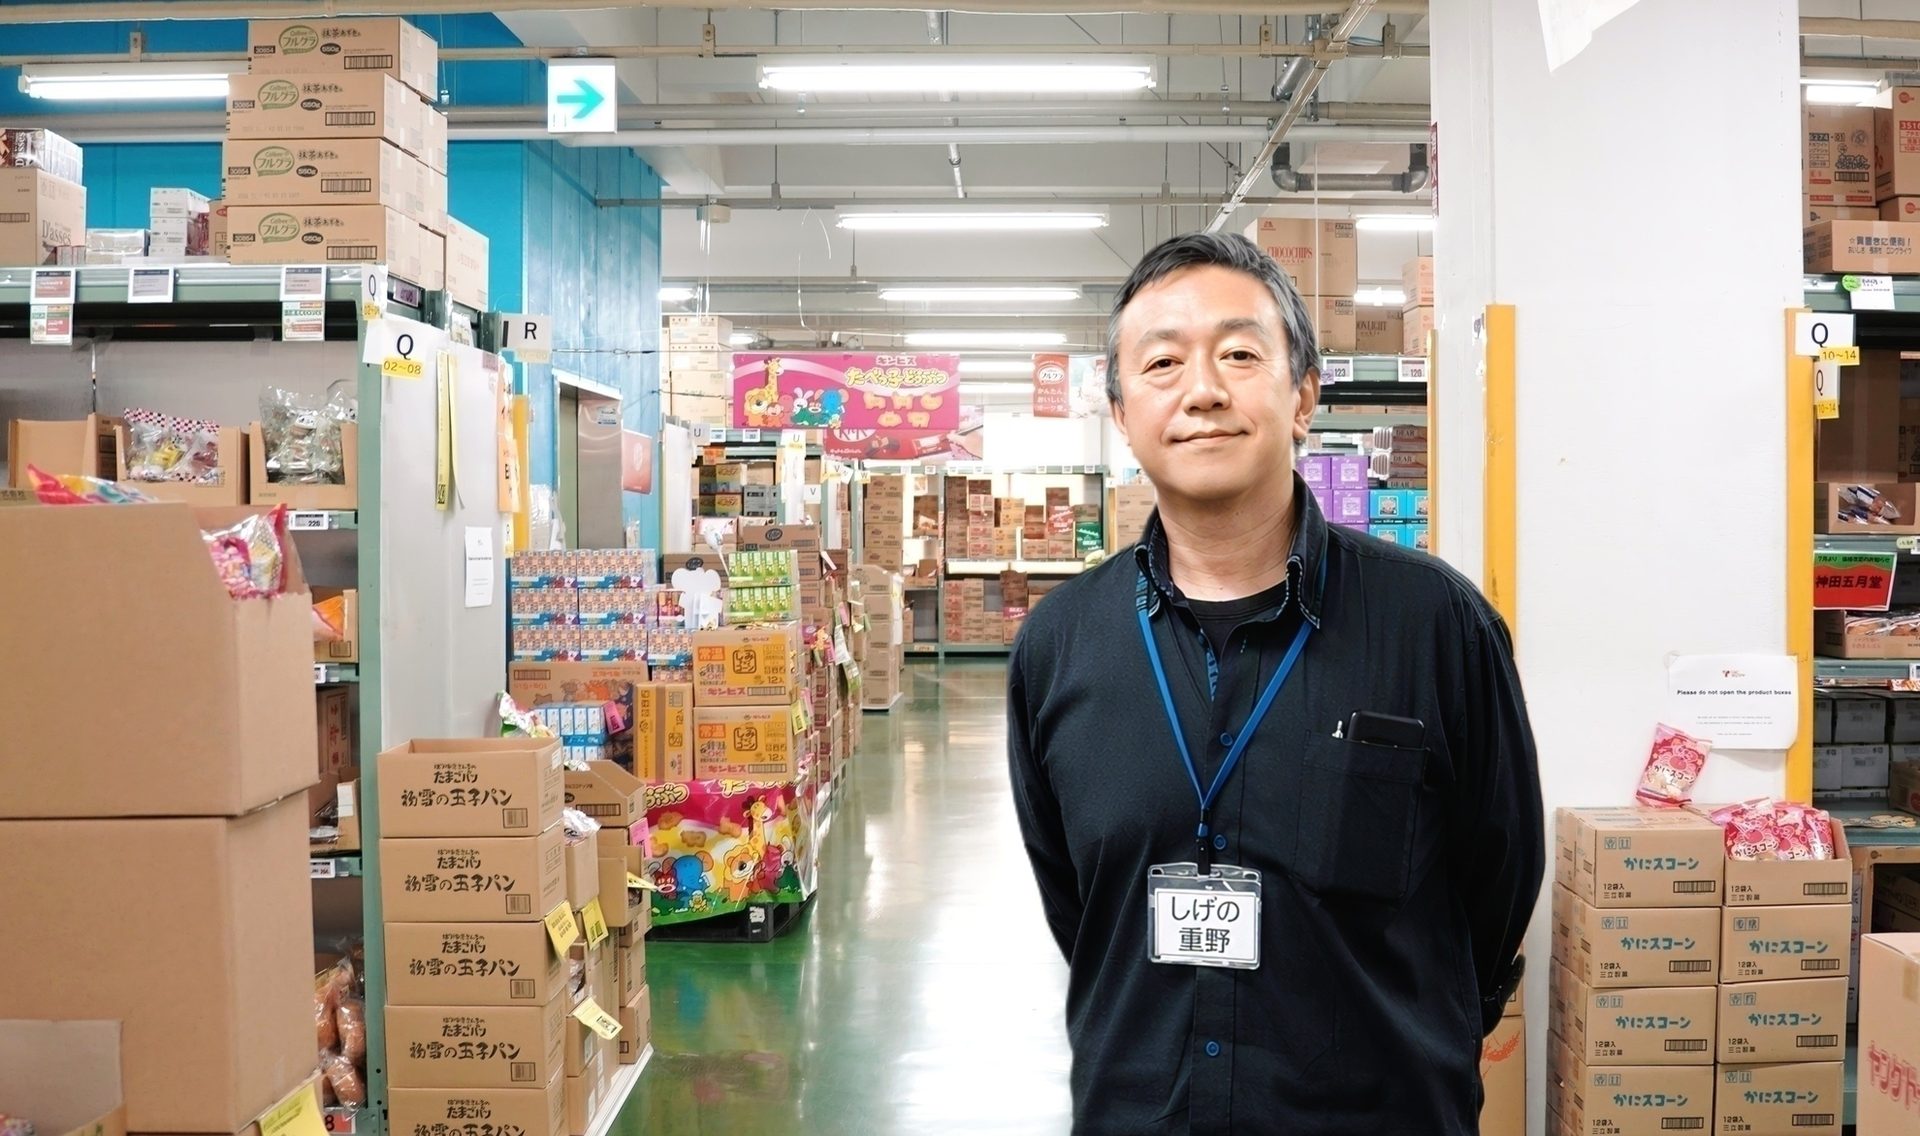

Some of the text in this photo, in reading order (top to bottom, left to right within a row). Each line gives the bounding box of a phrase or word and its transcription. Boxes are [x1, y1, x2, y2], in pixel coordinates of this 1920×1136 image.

[282, 36, 316, 48] フルグラ
[262, 91, 296, 102] フルグラ
[257, 157, 292, 168] フルグラ
[262, 224, 298, 235] フルグラ
[368, 274, 376, 300] Q
[524, 322, 538, 340] R
[1812, 322, 1828, 348] Q
[396, 334, 414, 360] Q
[846, 367, 950, 388] たべっ子どうぶつ
[1816, 370, 1824, 396] Q
[694, 428, 701, 437] U
[792, 434, 800, 442] U
[810, 488, 816, 496] V
[1816, 575, 1882, 588] 神田五月堂
[736, 650, 754, 660] しみ
[737, 728, 755, 738] しみ
[434, 770, 478, 784] たまごパン
[1654, 764, 1694, 784] かにスコーン
[1734, 842, 1778, 856] かにスコーン
[1788, 849, 1806, 860] コーン
[437, 856, 482, 870] たまごパン
[1624, 858, 1699, 871] かにスコーン
[1172, 896, 1240, 922] しげの
[442, 940, 486, 954] たまごパン
[1178, 928, 1230, 953] 重野
[1620, 937, 1696, 950] かにスコーン
[1749, 940, 1828, 954] かにスコーン
[1616, 1016, 1692, 1029] かにスコーン
[1748, 1014, 1822, 1026] かにスコーン
[442, 1024, 486, 1037] たまごパン
[1613, 1094, 1688, 1106] かにスコーン
[1744, 1091, 1818, 1104] かにスコーン
[446, 1106, 492, 1119] たまごパン
